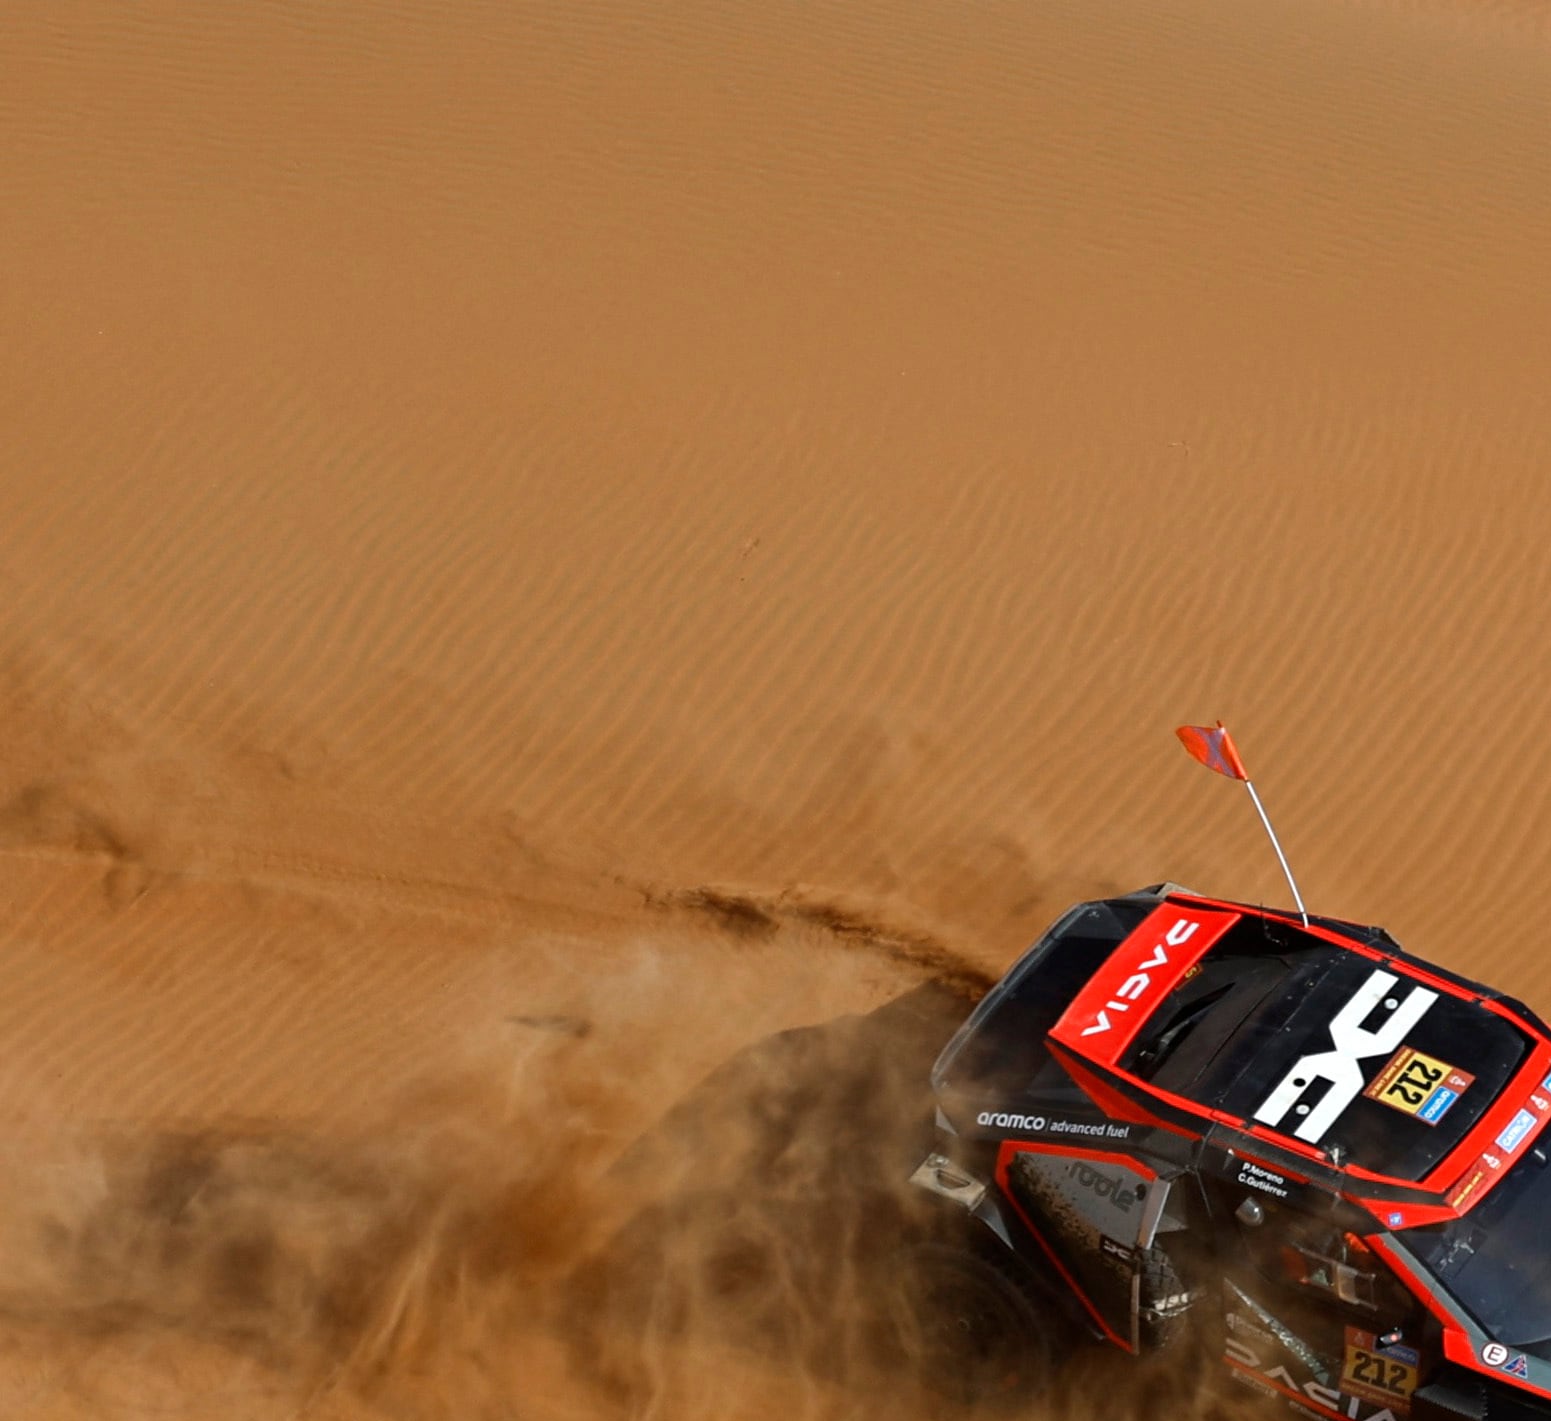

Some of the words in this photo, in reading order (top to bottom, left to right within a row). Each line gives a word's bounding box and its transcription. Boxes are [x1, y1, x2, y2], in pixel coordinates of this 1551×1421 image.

[1386, 1060, 1443, 1105] 212
[977, 1112, 1046, 1131] aramco
[1050, 1121, 1105, 1136] advanced
[1106, 1125, 1130, 1138] fuel
[1487, 1346, 1503, 1362] E
[1352, 1351, 1408, 1395] 212
